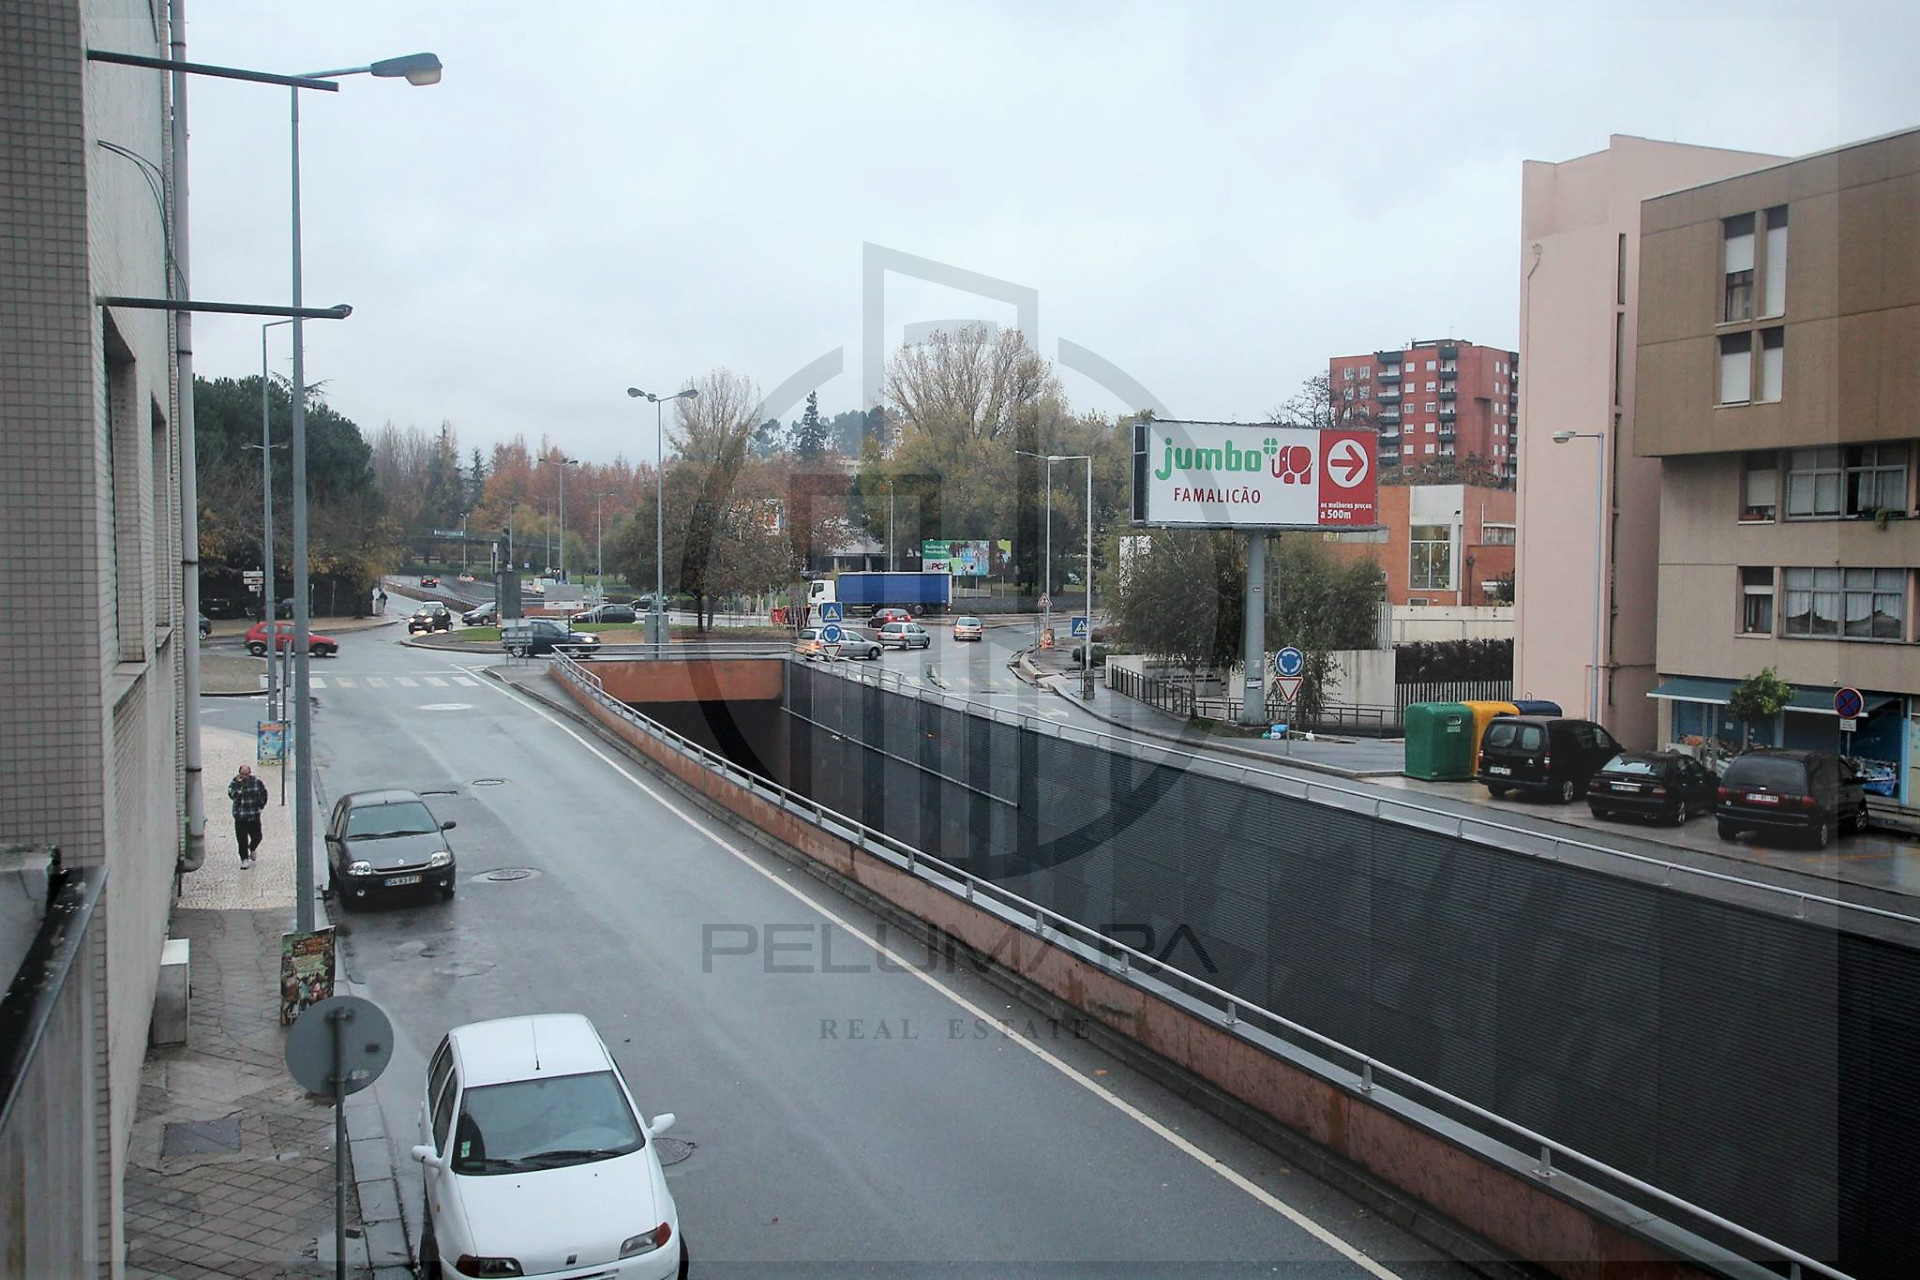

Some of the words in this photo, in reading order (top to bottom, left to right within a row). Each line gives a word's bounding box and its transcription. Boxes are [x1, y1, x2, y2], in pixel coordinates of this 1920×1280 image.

[1155, 437, 1262, 481] jumbo
[1174, 486, 1261, 504] FAMALICÃO
[1327, 510, 1351, 519] 500m
